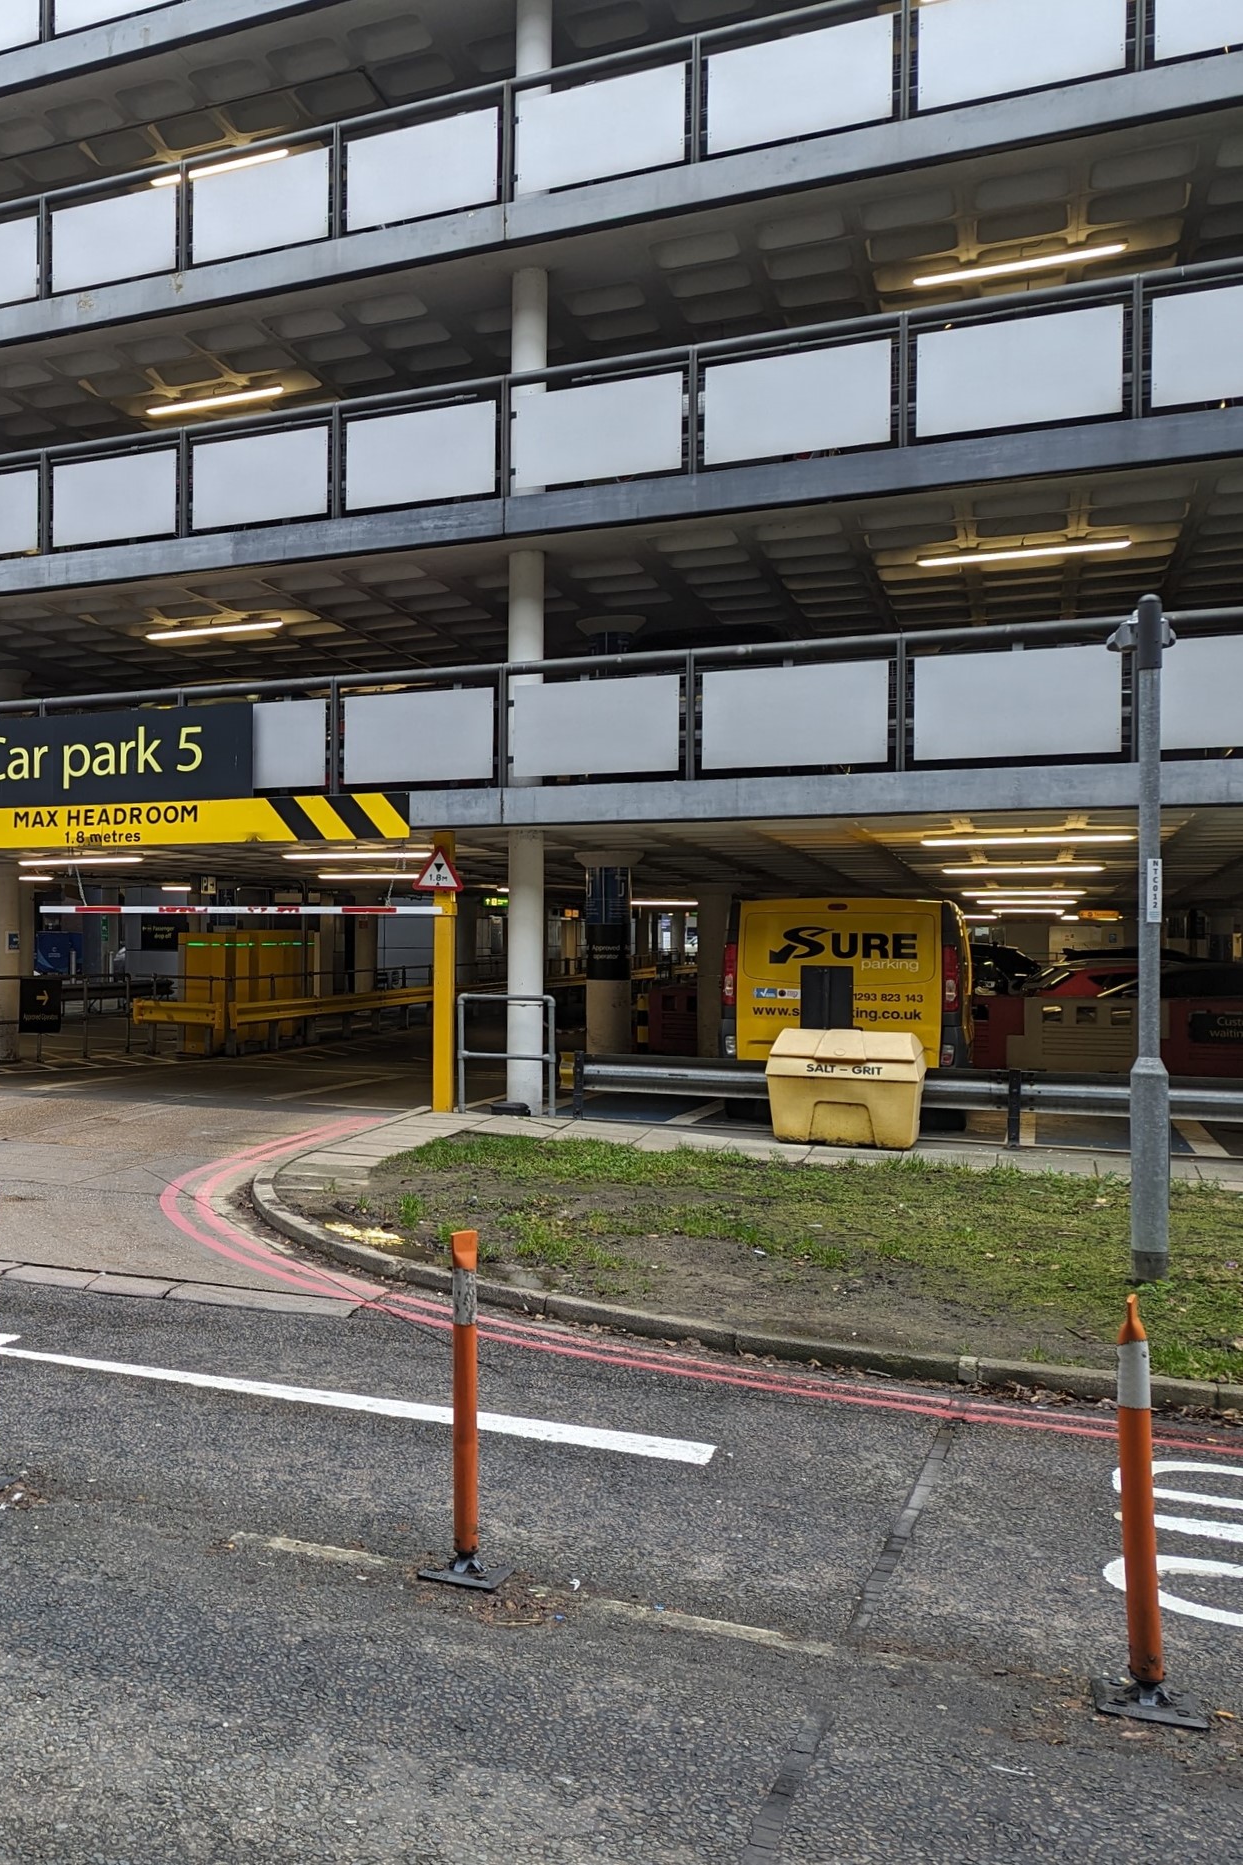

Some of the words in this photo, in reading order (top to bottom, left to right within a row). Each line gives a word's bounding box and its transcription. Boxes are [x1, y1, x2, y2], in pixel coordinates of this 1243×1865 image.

[63, 726, 162, 790] park
[176, 726, 203, 772] 5
[14, 810, 58, 828] MAX
[67, 805, 198, 826] HEADROOM
[65, 831, 85, 844] 1.8
[89, 831, 141, 843] metres
[591, 944, 620, 952] Approved
[781, 926, 918, 959] SURE
[861, 959, 919, 972] parking
[853, 992, 877, 1001] 1293
[881, 993, 901, 1002] 823
[906, 993, 924, 1003] 143
[752, 1004, 922, 1022] www.sing.co.uk
[1217, 1016, 1243, 1027] Cust
[806, 1063, 836, 1074] SALT
[851, 1065, 883, 1076] GRIT
